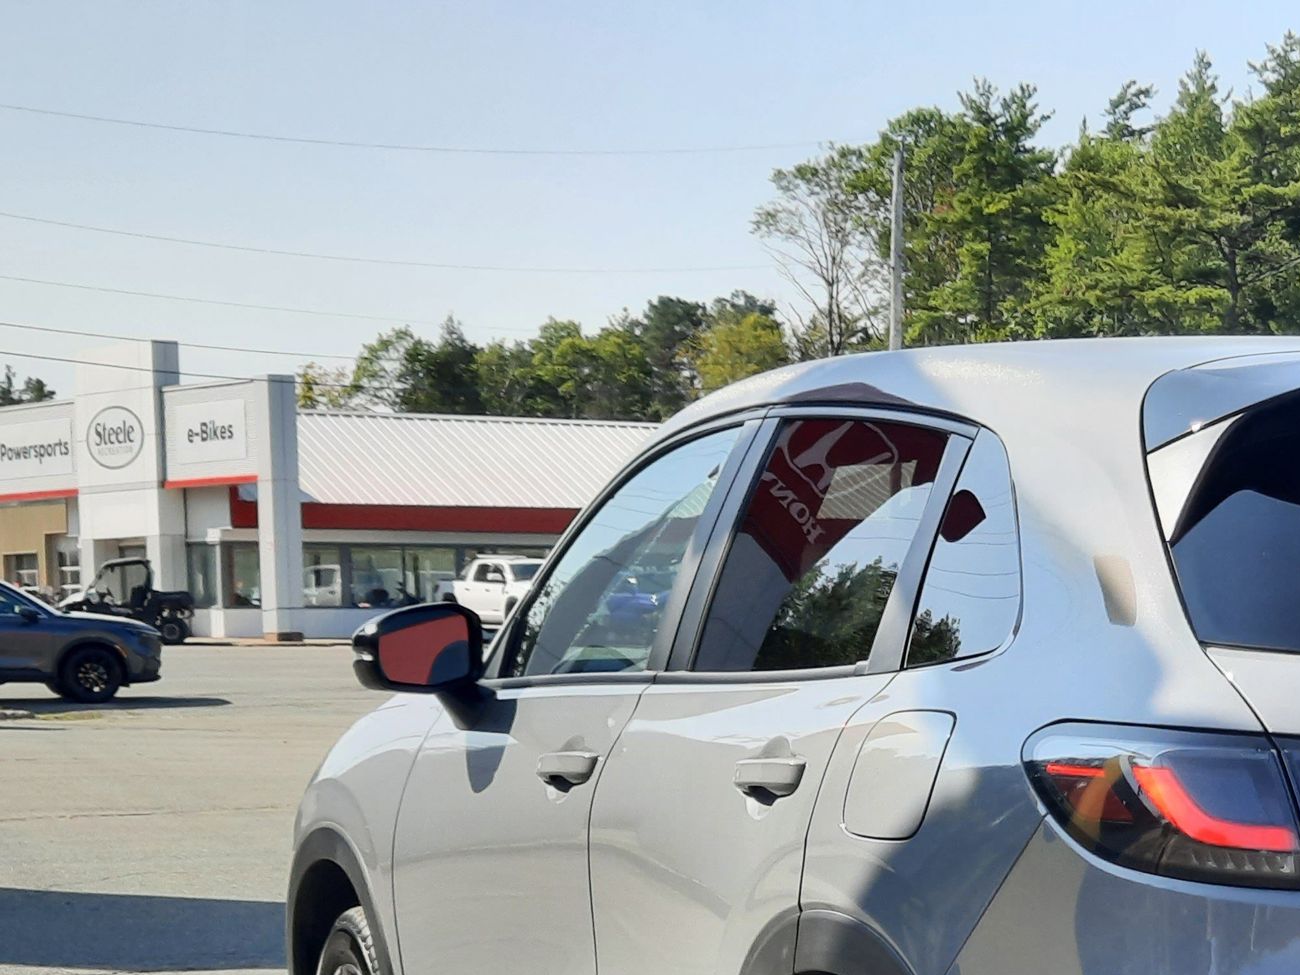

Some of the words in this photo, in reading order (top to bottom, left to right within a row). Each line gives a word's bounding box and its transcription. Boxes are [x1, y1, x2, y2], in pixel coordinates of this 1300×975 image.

[95, 420, 135, 446] Steele
[187, 420, 234, 443] e-Bikes
[0, 438, 70, 464] Powersports
